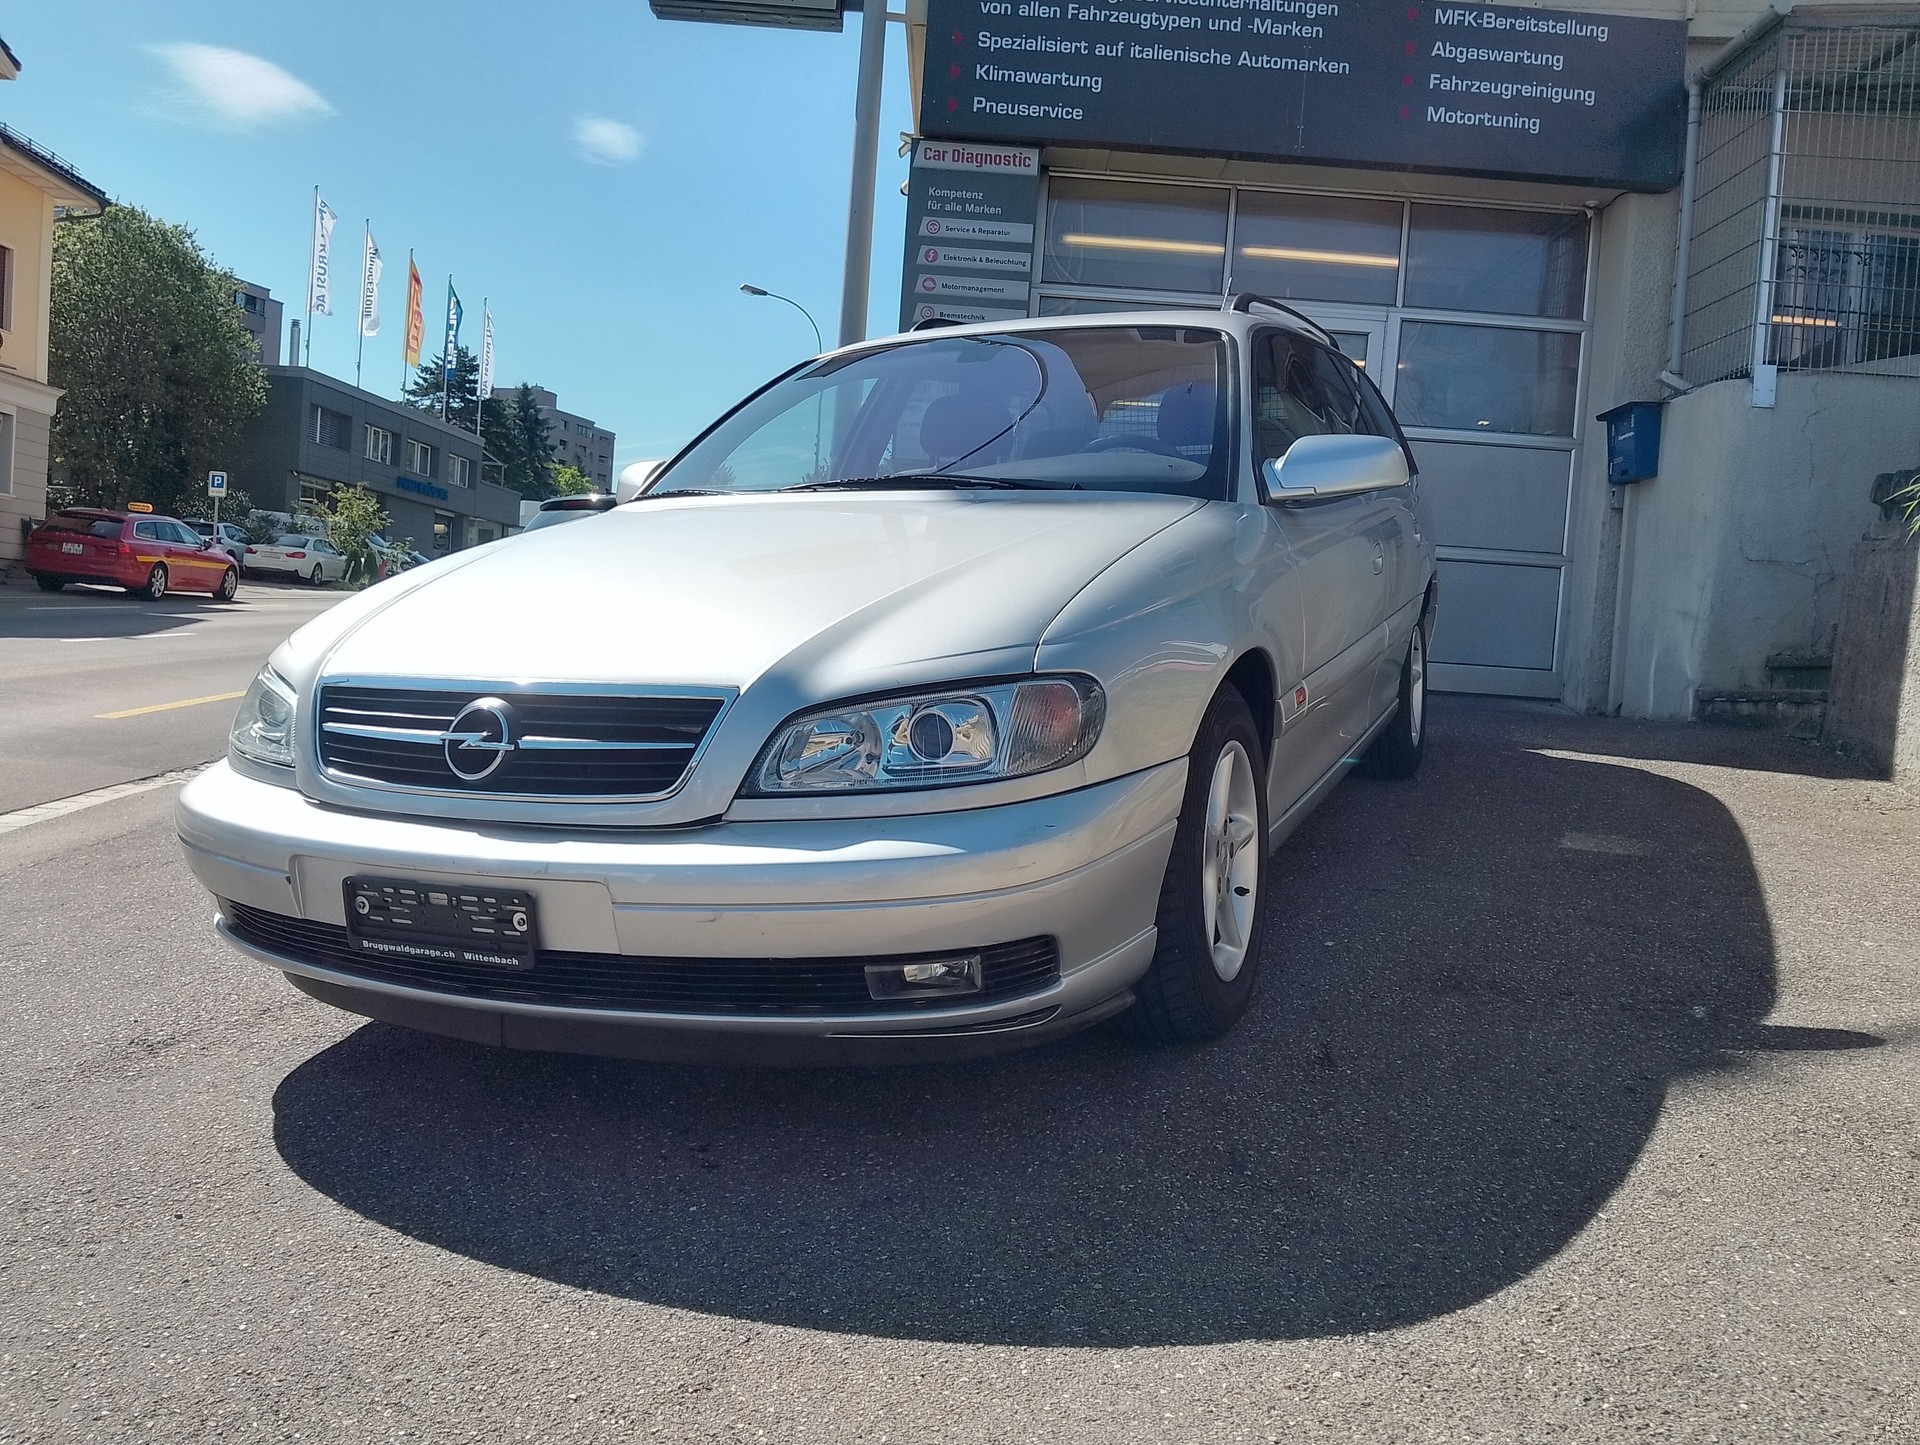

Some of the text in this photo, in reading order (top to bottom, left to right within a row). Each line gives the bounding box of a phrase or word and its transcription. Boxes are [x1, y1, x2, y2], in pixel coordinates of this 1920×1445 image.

[980, 1, 1323, 39] von allen Fahrzeugtypen und -Marken
[1434, 8, 1609, 42] MFK-Bereitstellung
[977, 31, 1350, 75] Spezialisiert auf italienische Automarken
[1431, 41, 1564, 71] Abgaswartung
[975, 64, 1102, 92] Klimawartung
[1429, 73, 1596, 106] Fahrzeugreinigung
[972, 97, 1083, 120] Pneuservice
[1426, 106, 1541, 134] Motortuning
[923, 147, 1032, 168] Car Diagnostic
[928, 187, 984, 200] Kompetenz
[927, 200, 1002, 215] für alle Marken
[945, 225, 970, 233] Service
[978, 228, 1011, 236] Reparatur
[943, 254, 977, 262] Elektronik
[985, 257, 1027, 267] Beleuchtung
[941, 283, 1005, 293] Motormanagement
[940, 311, 985, 321] Bremstechnik
[214, 476, 222, 487] P
[362, 940, 519, 966] Bruggwaldgarage.ch Wittenbach
